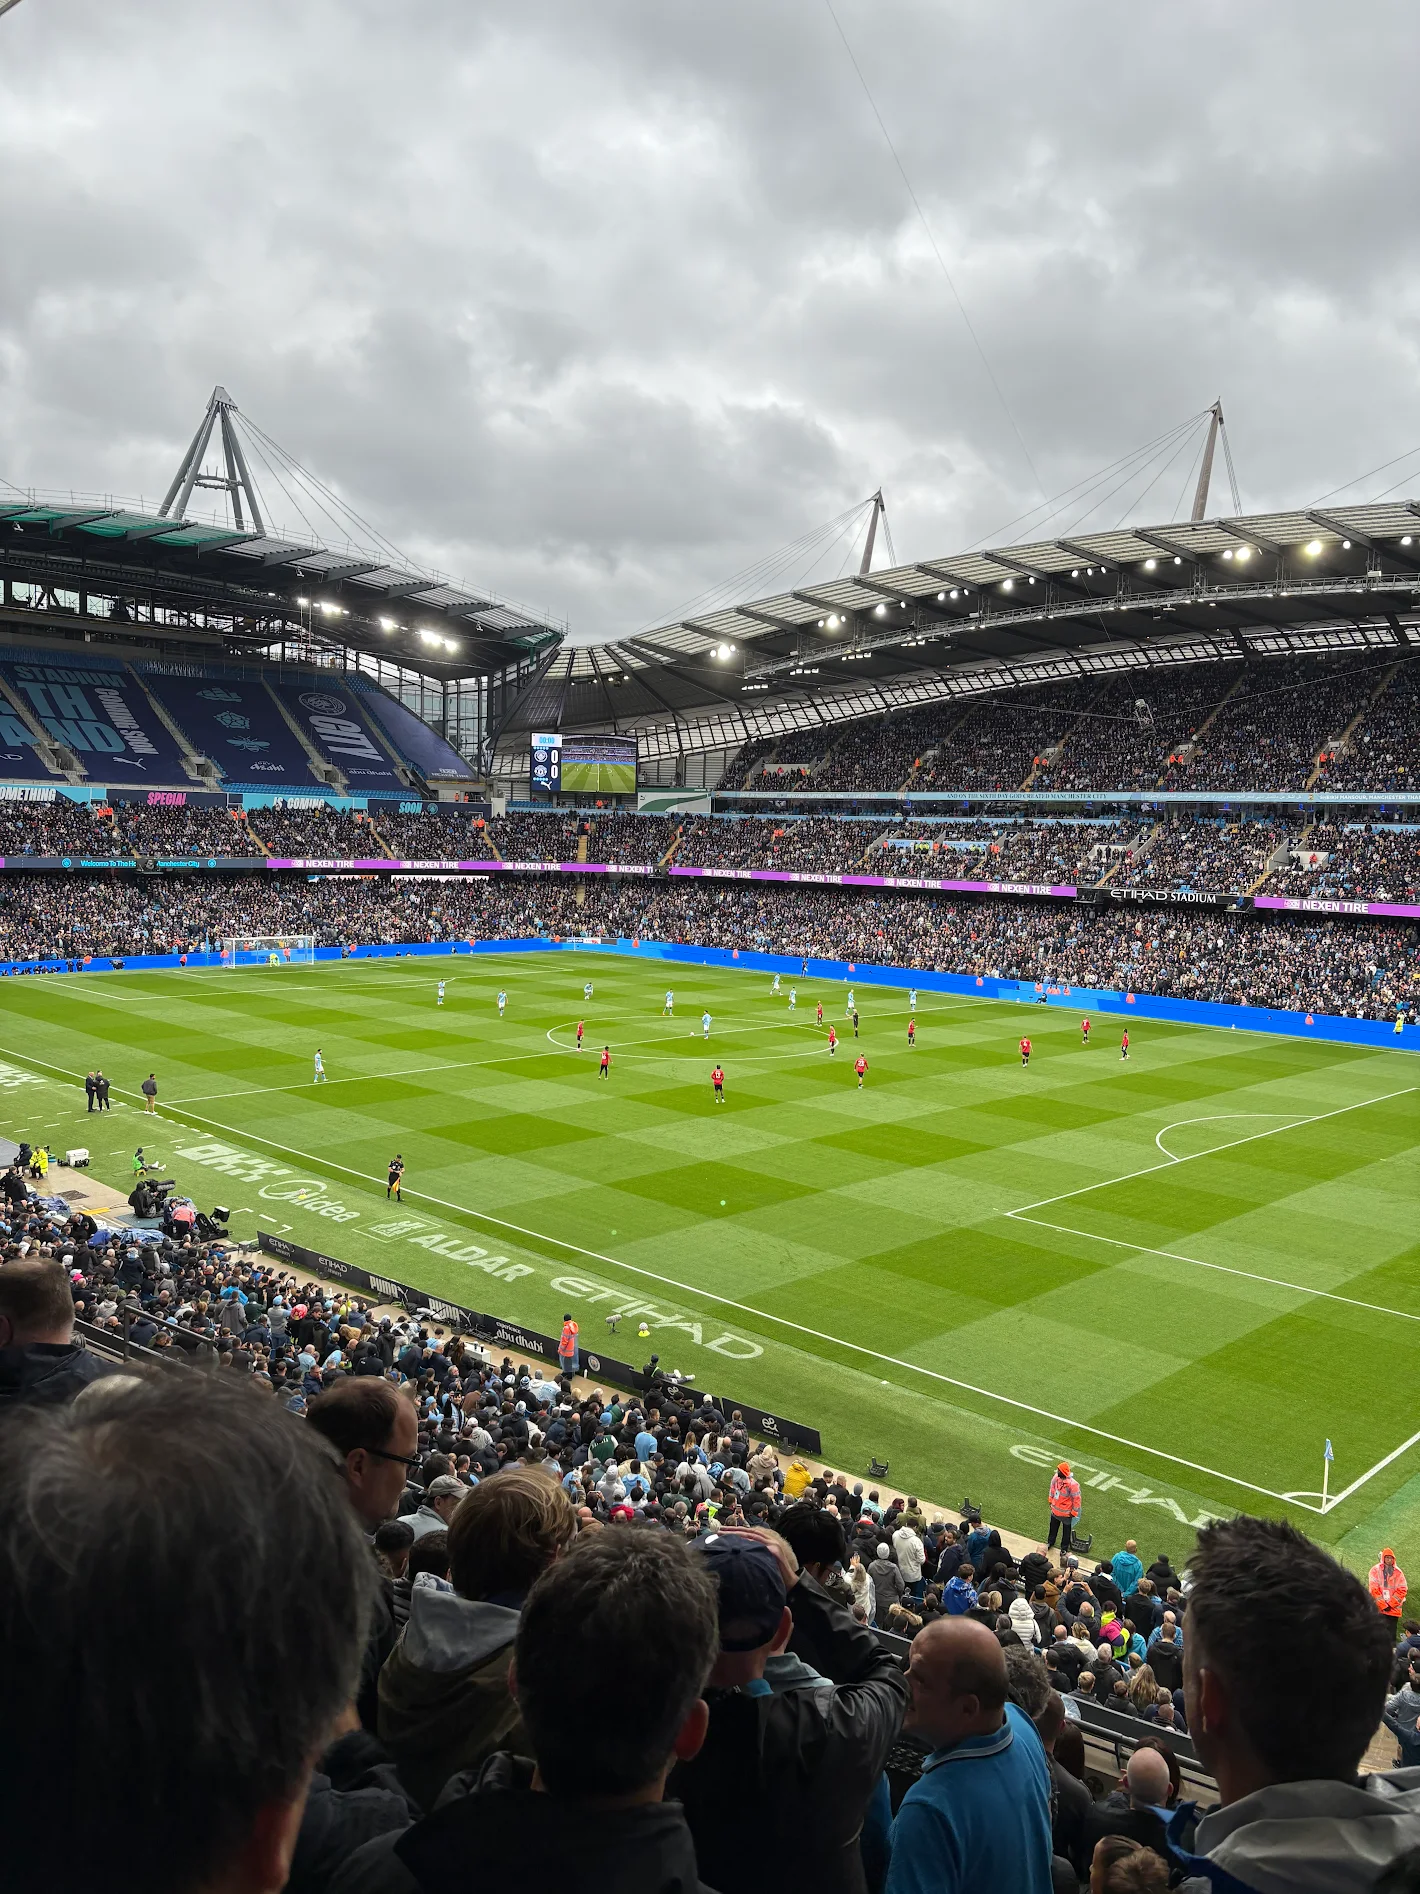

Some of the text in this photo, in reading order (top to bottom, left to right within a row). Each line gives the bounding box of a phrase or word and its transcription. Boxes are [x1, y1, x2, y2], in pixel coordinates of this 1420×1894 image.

[14, 666, 127, 688] STADIUM
[95, 688, 159, 754] COMING SOON
[309, 716, 384, 762] CITY
[551, 750, 558, 764] 0
[551, 765, 558, 778] 0
[0, 786, 56, 801] OMETHING
[147, 792, 187, 805] SPECIAL
[287, 798, 325, 810] COMING
[399, 802, 423, 814] SOON
[897, 878, 922, 887] NEXEN
[924, 880, 941, 888] TIRE
[1002, 884, 1029, 893] NEXEN
[1032, 885, 1051, 894] TIRE
[1111, 889, 1216, 903] ETIHAD STADIUM
[1303, 901, 1339, 911] NEXEN
[1343, 902, 1368, 912] TIRE
[173, 1144, 293, 1182] OKX
[319, 1257, 347, 1273] ETIHAD
[407, 1234, 535, 1282] ALDAR
[369, 1276, 398, 1298] PUMA
[428, 1298, 460, 1322] PUMA
[550, 1276, 764, 1359] ETIHAD
[496, 1321, 521, 1334] experience
[497, 1328, 543, 1354] abu dhabi
